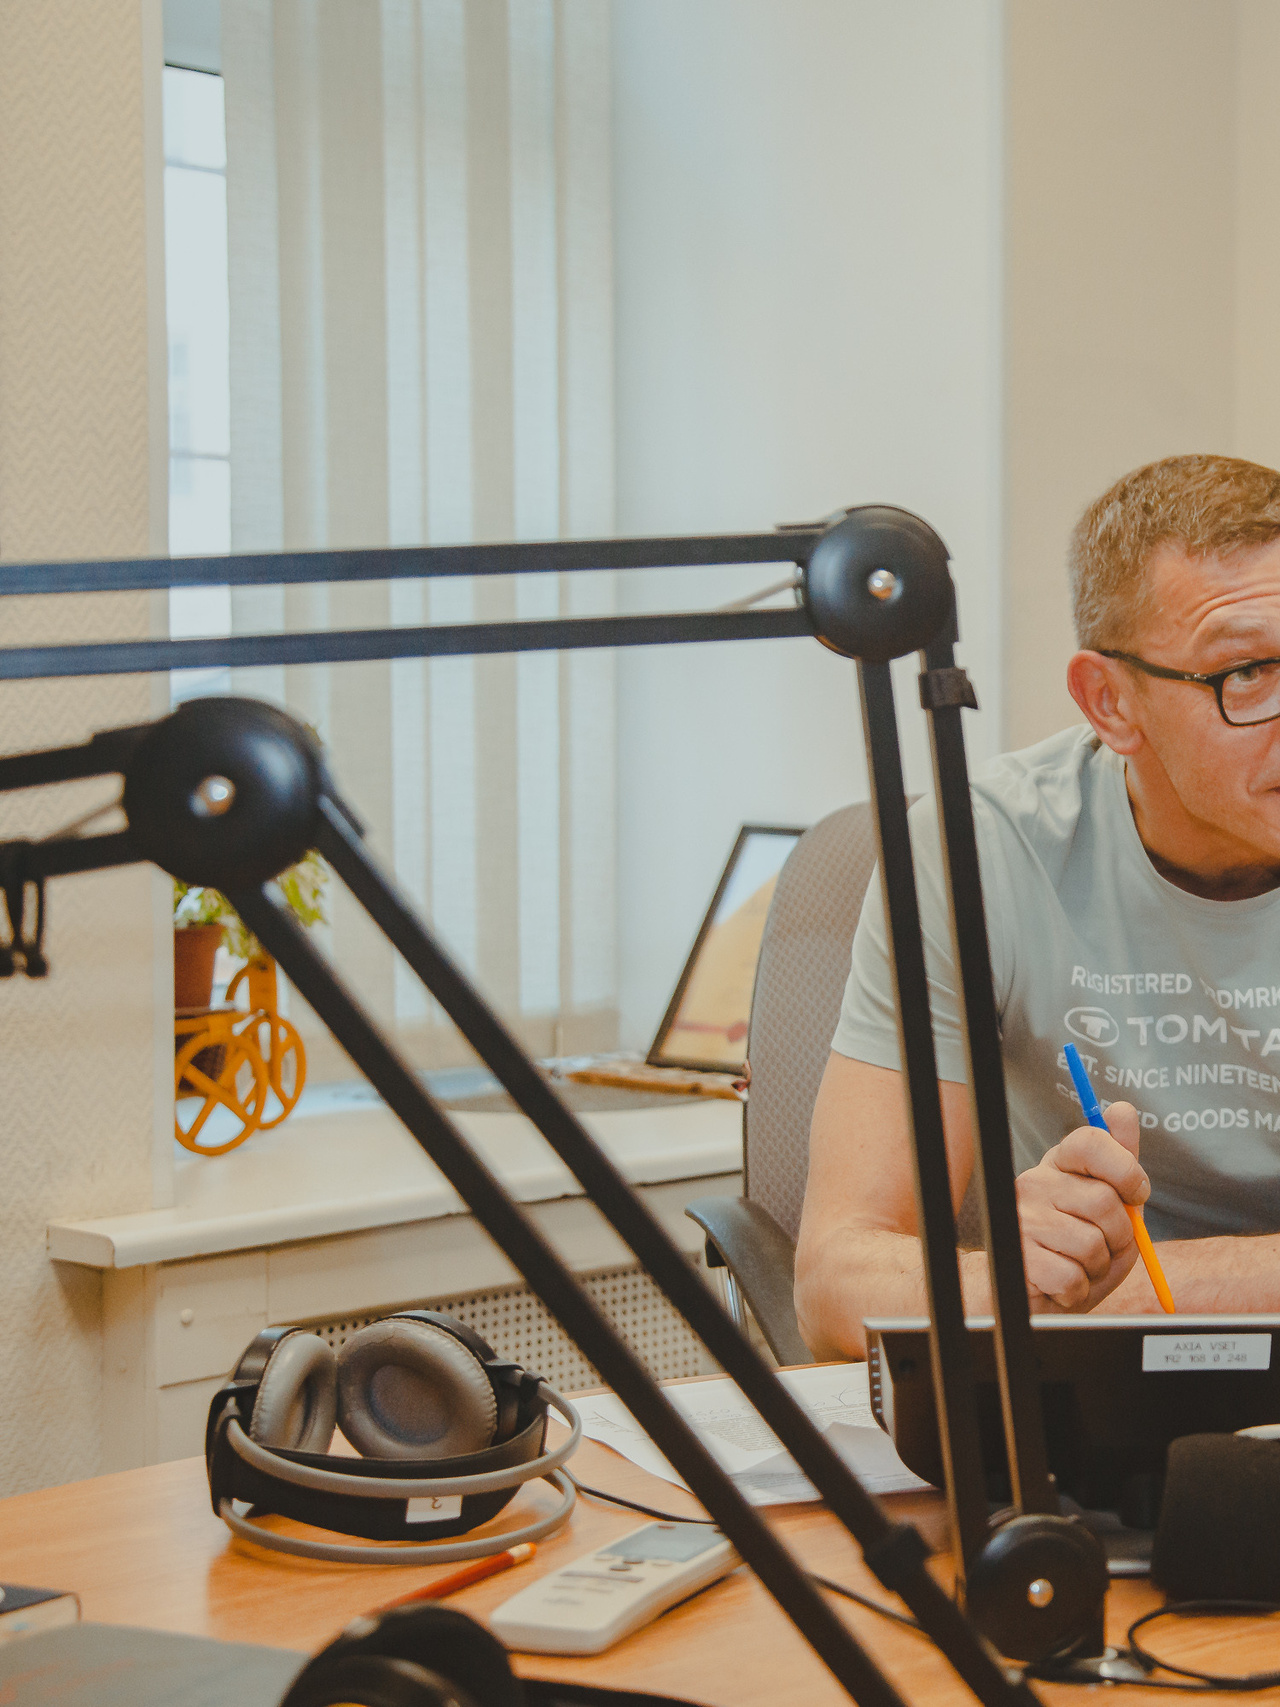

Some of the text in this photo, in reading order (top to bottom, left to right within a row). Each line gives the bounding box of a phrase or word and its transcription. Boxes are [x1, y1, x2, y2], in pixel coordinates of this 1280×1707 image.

[1070, 965, 1193, 994] REGISTERED
[1126, 1013, 1228, 1046] TOM
[1057, 1051, 1099, 1076] ET.
[1105, 1065, 1170, 1089] SINCE
[1163, 1108, 1250, 1132] GOODS
[1174, 1342, 1202, 1351] AXIA
